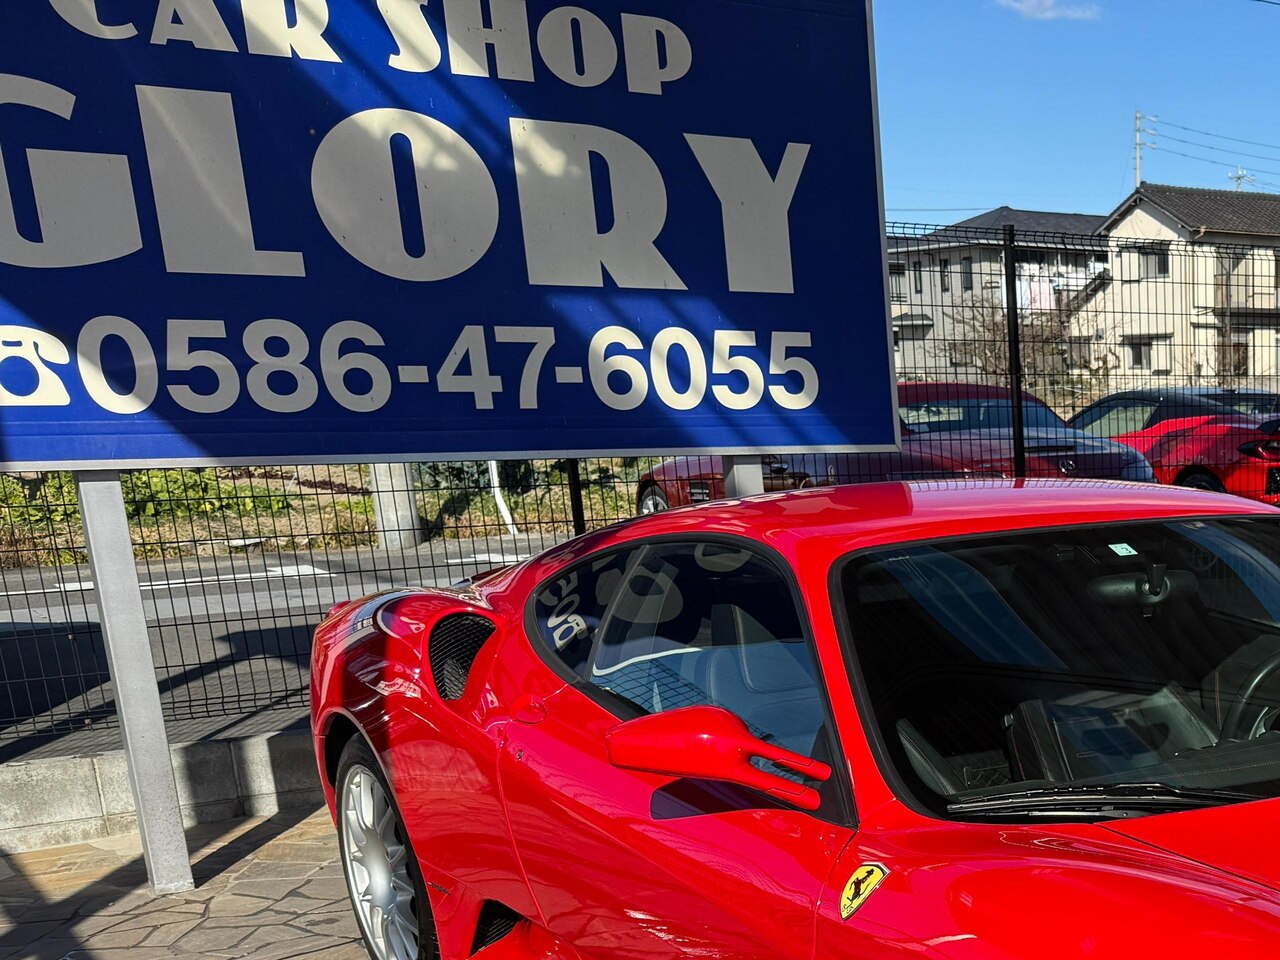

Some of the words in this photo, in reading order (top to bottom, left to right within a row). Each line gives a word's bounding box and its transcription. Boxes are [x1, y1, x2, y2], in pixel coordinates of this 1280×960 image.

[388, 0, 693, 95] SHOP
[0, 73, 812, 294] GLORY
[76, 314, 820, 414] 0586-47-6055
